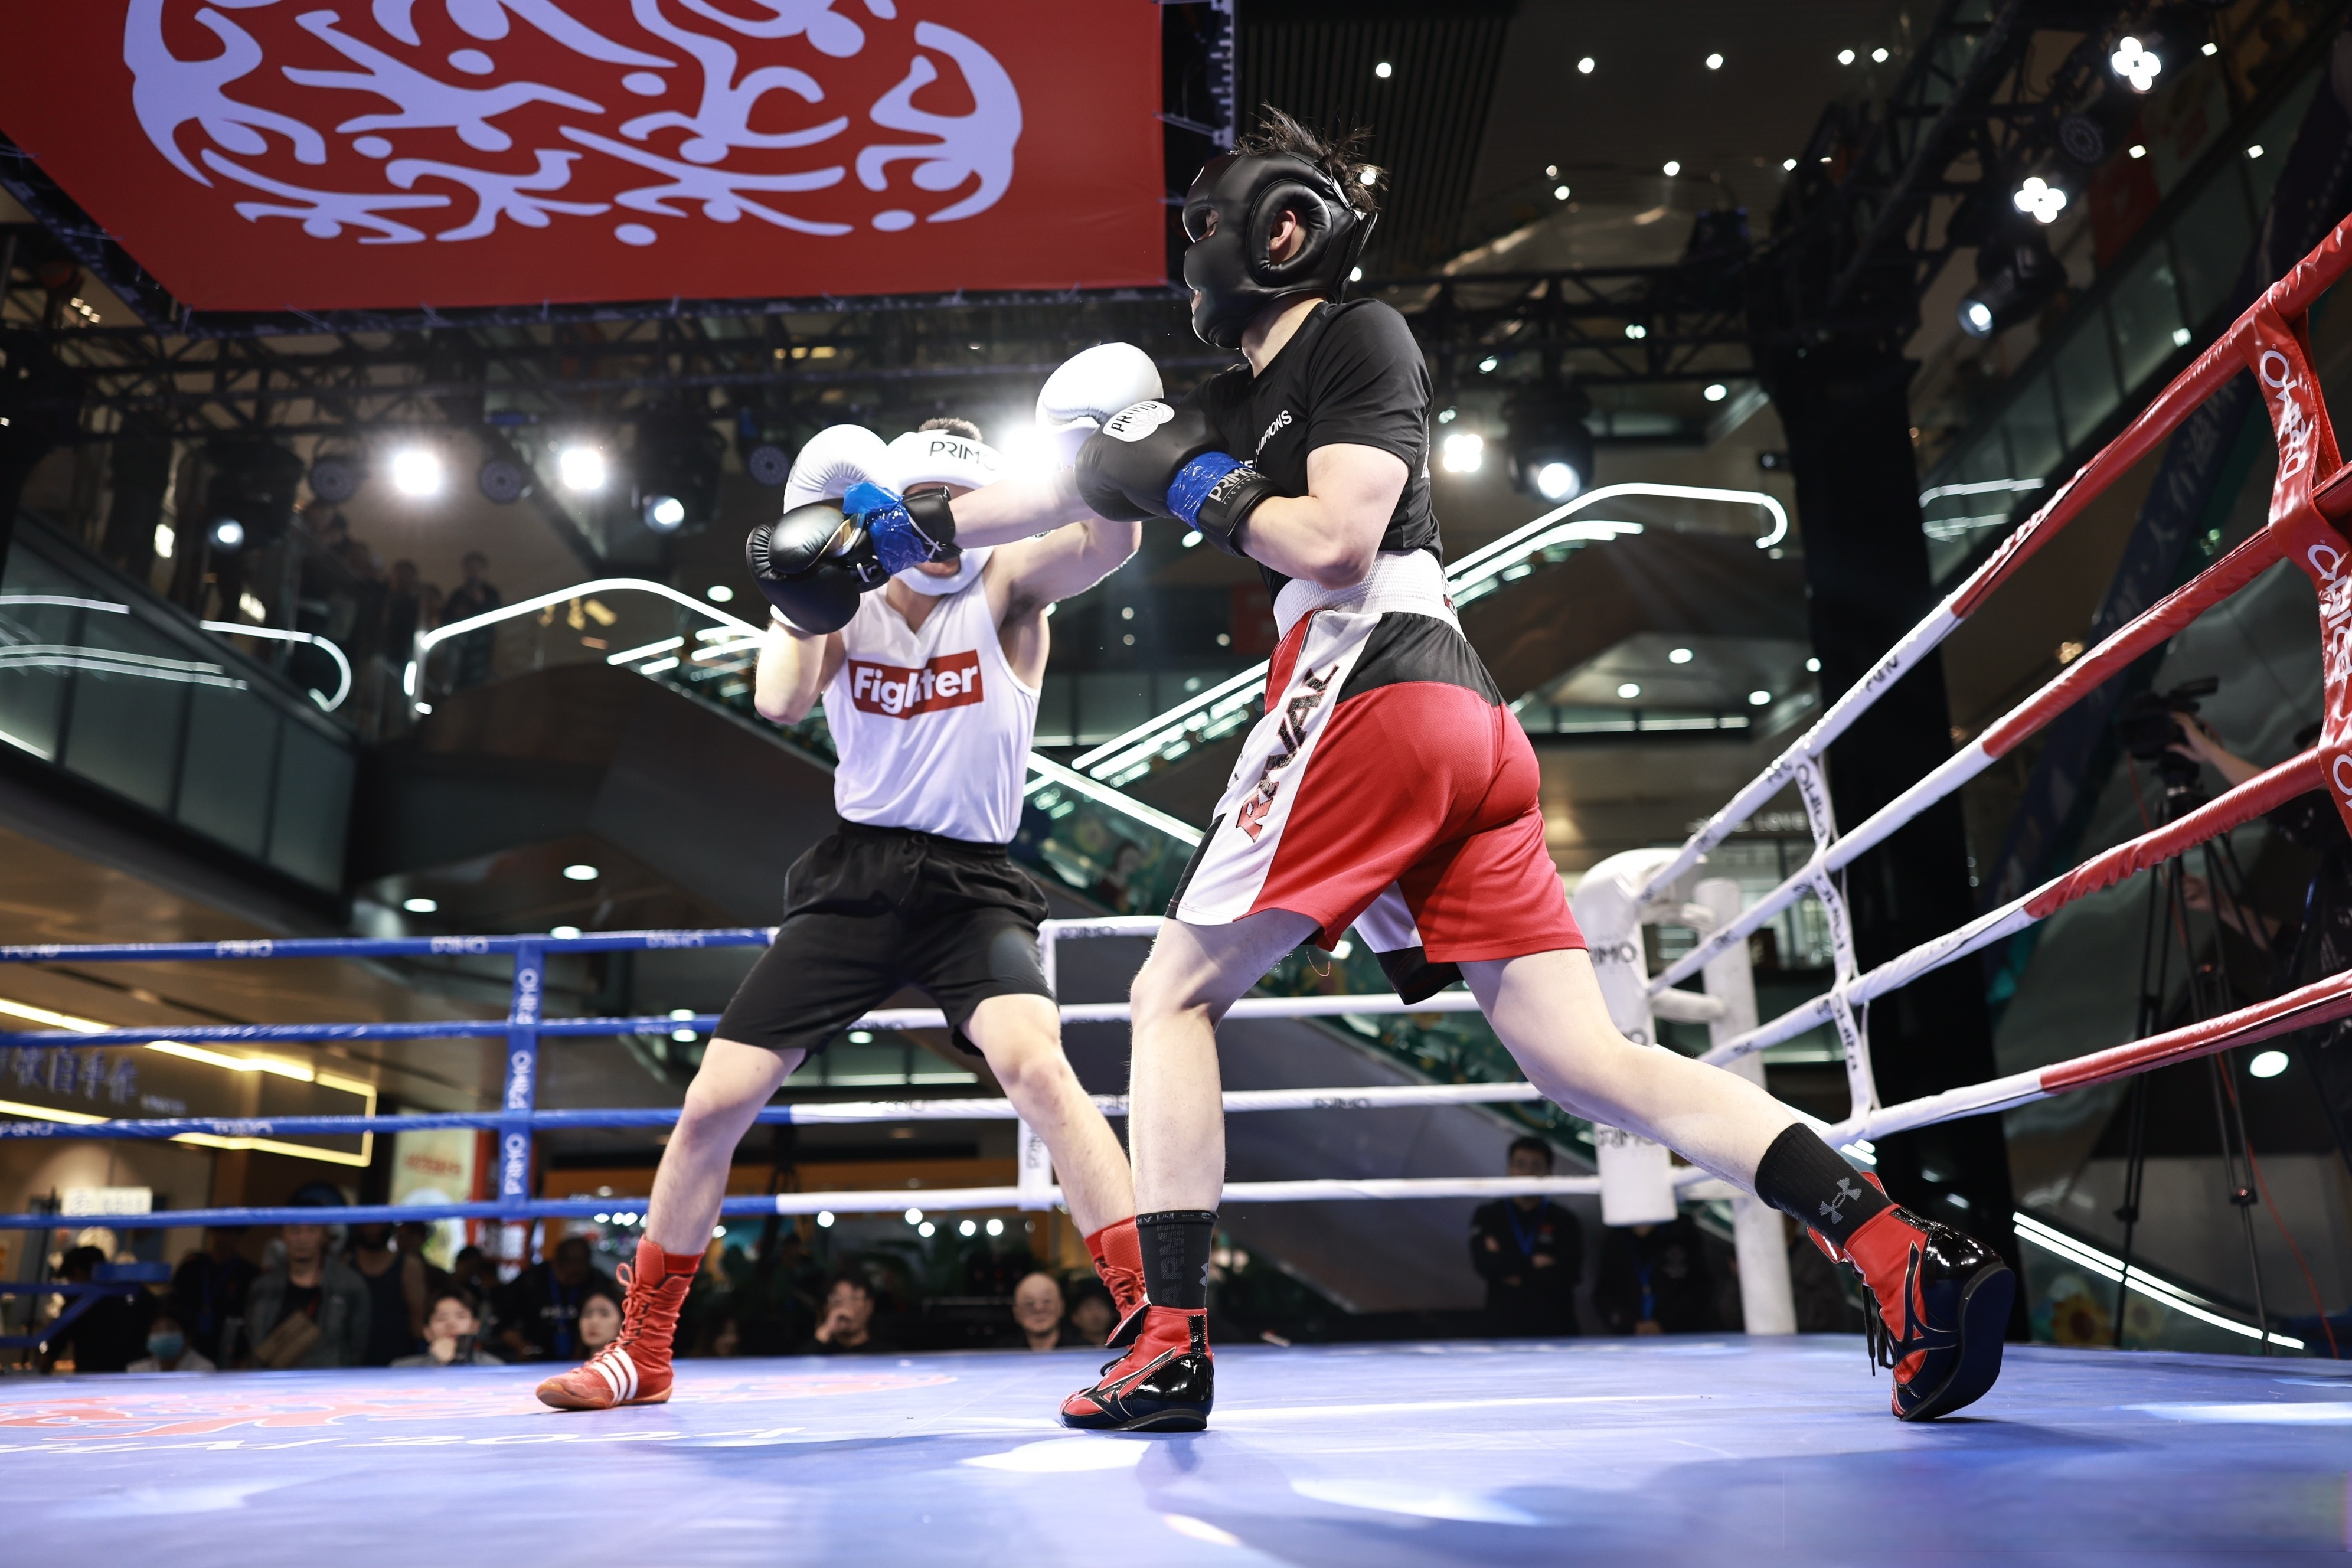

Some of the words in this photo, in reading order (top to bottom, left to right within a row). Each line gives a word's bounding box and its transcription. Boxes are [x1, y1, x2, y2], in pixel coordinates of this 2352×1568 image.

[1207, 467, 1256, 502] PRIMO
[854, 665, 979, 714] Fighter
[1236, 664, 1341, 843] RIVAL
